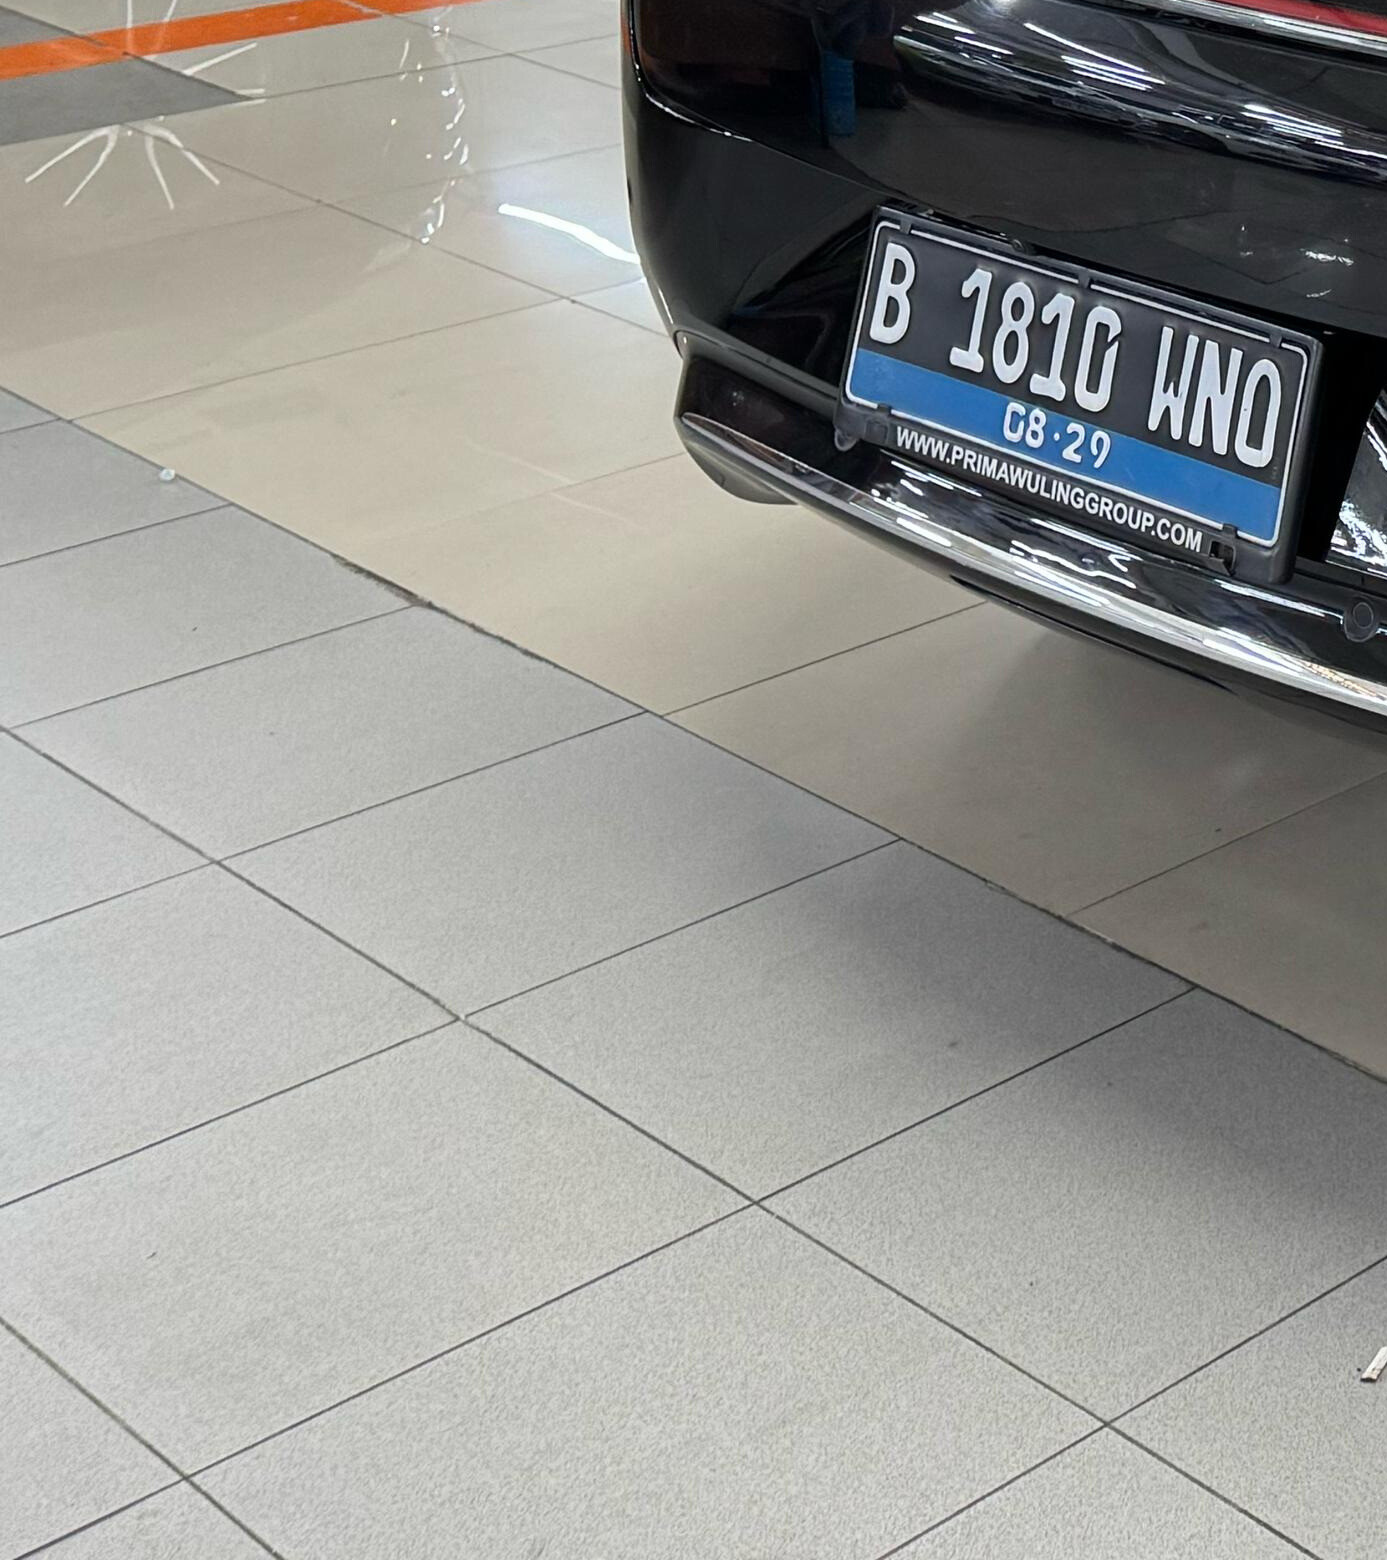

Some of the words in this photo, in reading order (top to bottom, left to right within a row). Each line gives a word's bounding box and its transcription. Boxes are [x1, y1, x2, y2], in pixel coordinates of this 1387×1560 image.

[869, 242, 916, 344] B
[949, 268, 1122, 412] 1810
[1148, 326, 1282, 468] WNO
[896, 426, 1203, 553] WWW.PRIMAWULINGGROUP.COM
